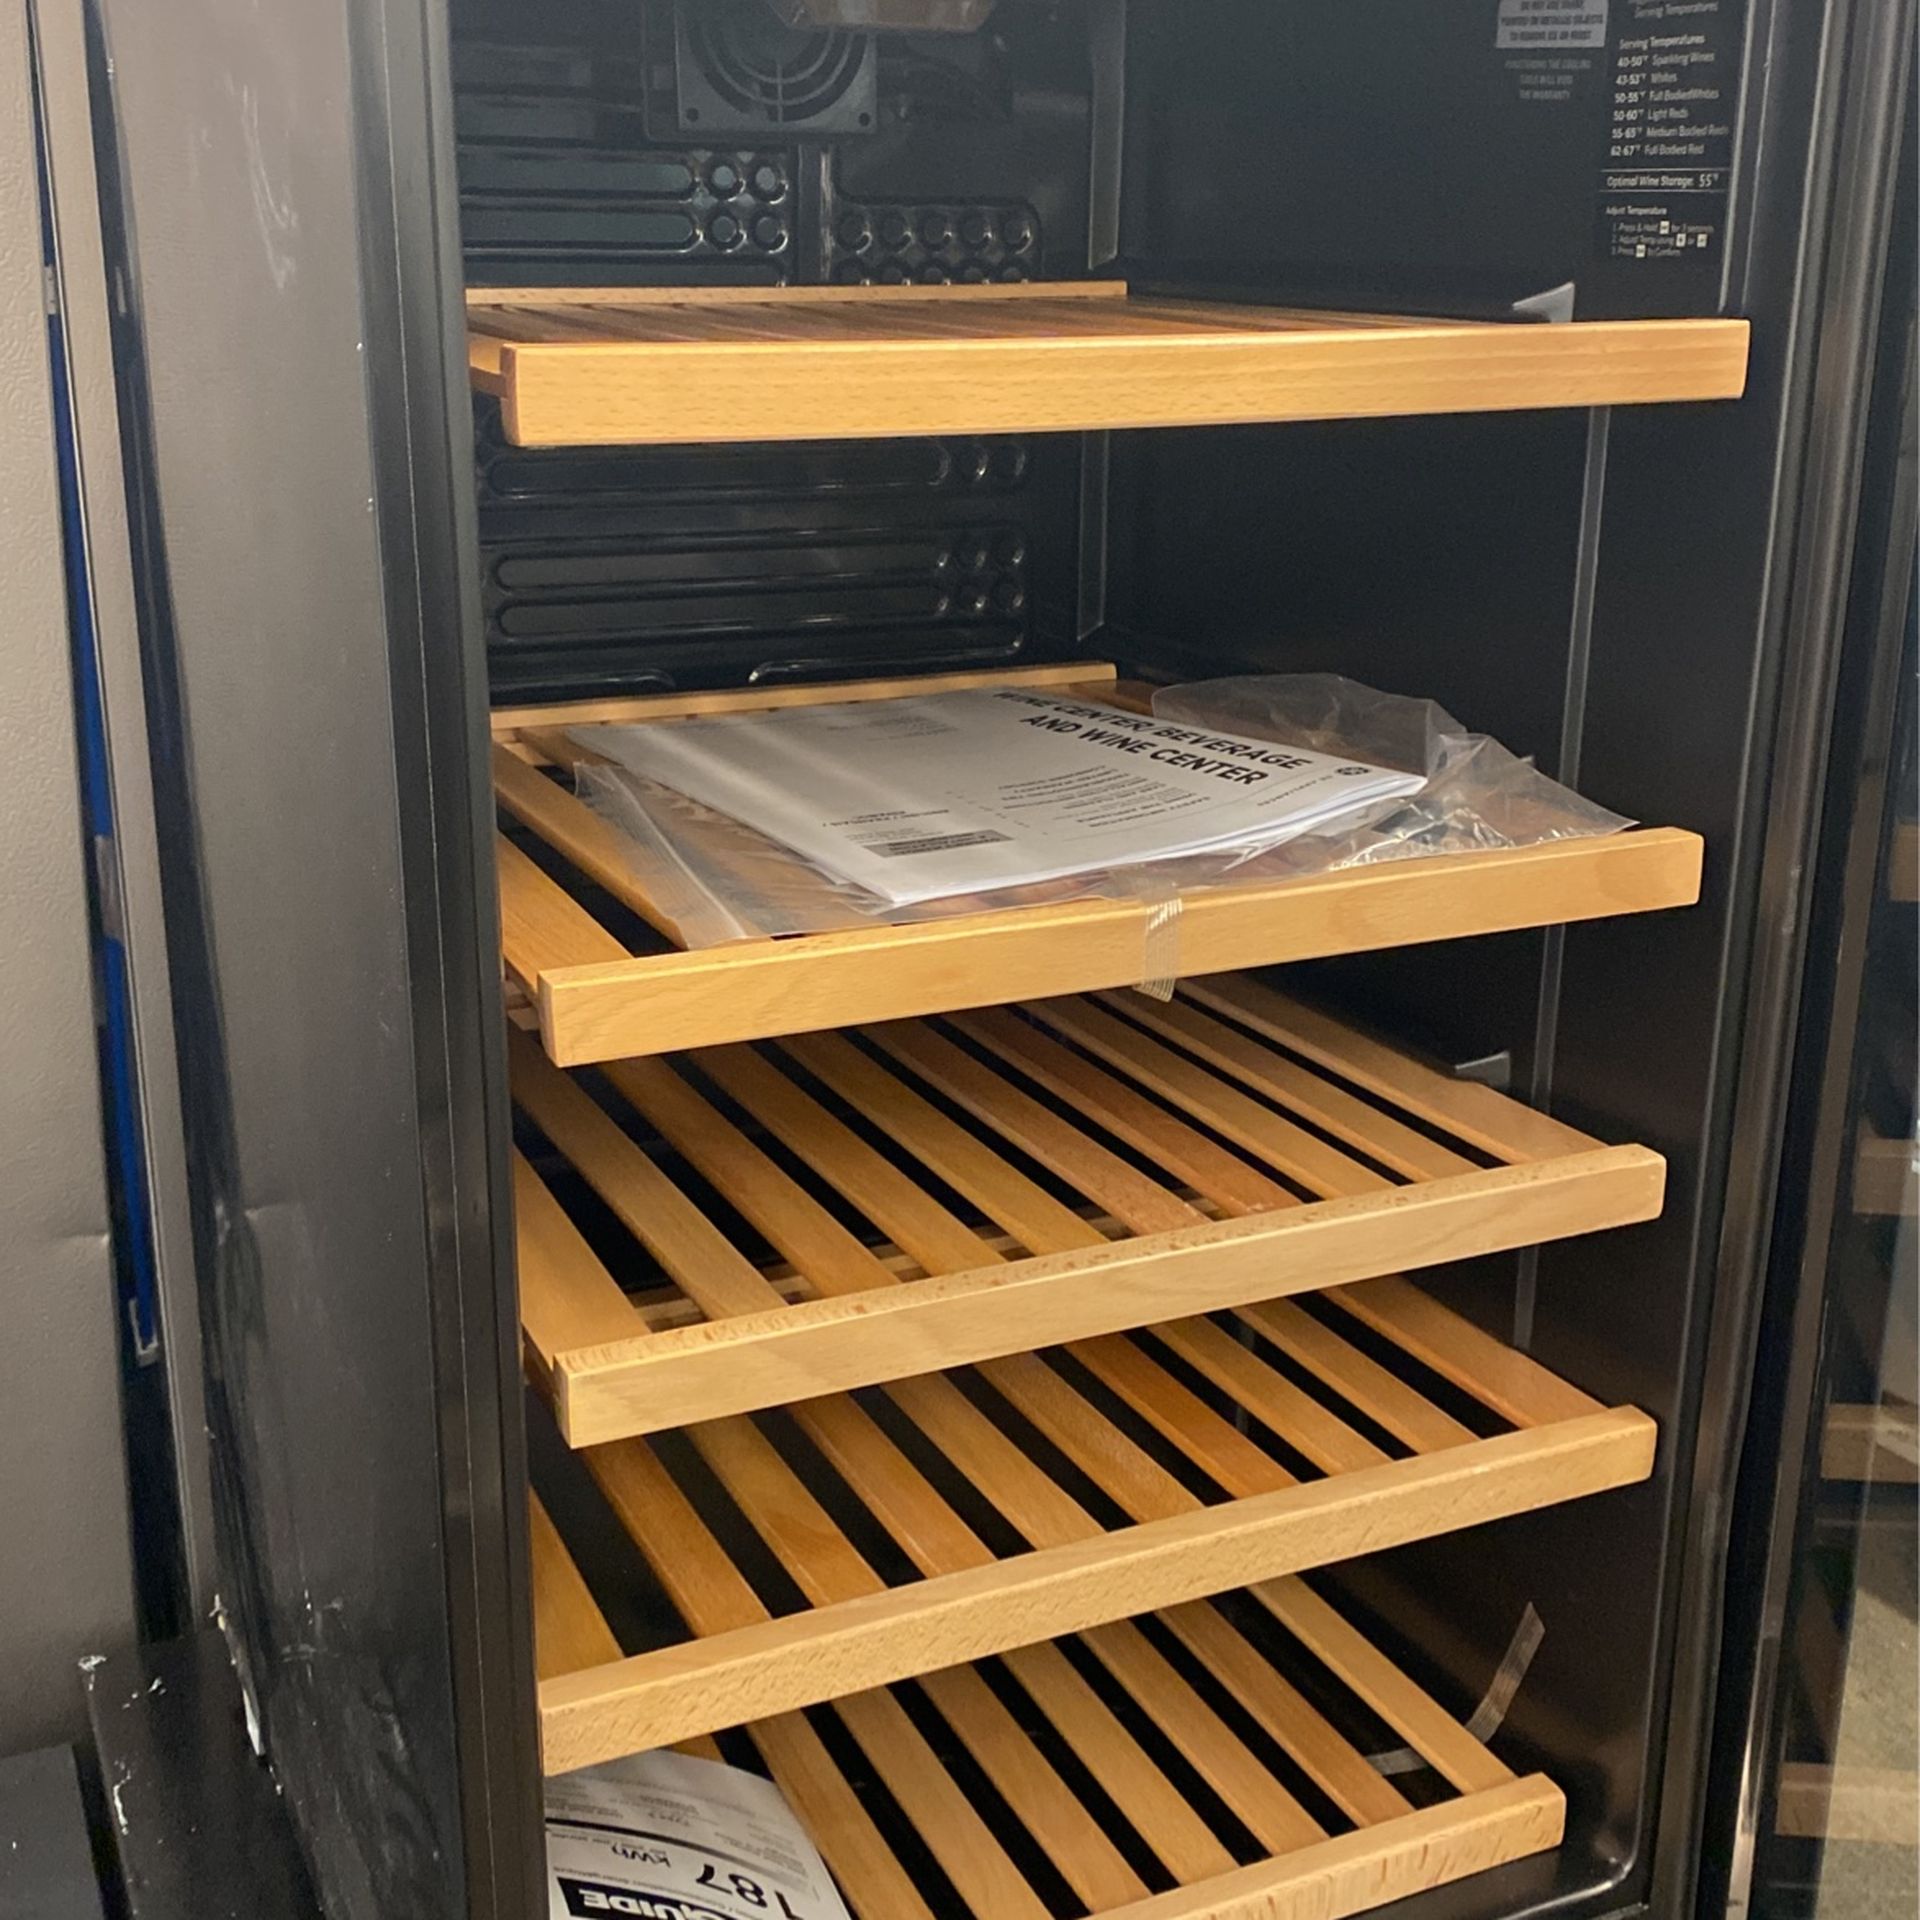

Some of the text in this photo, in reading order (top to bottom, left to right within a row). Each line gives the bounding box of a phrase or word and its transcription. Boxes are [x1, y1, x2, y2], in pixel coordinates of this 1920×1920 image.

[1619, 34, 1705, 50] Serving Temperatures
[1648, 109, 1667, 121] Light
[1606, 175, 1638, 188] Optimal
[1639, 175, 1659, 187] Wine
[1019, 714, 1083, 734] AND
[1078, 728, 1158, 754] WINE
[1149, 748, 1269, 785] CENTER
[695, 1863, 804, 1920] 187
